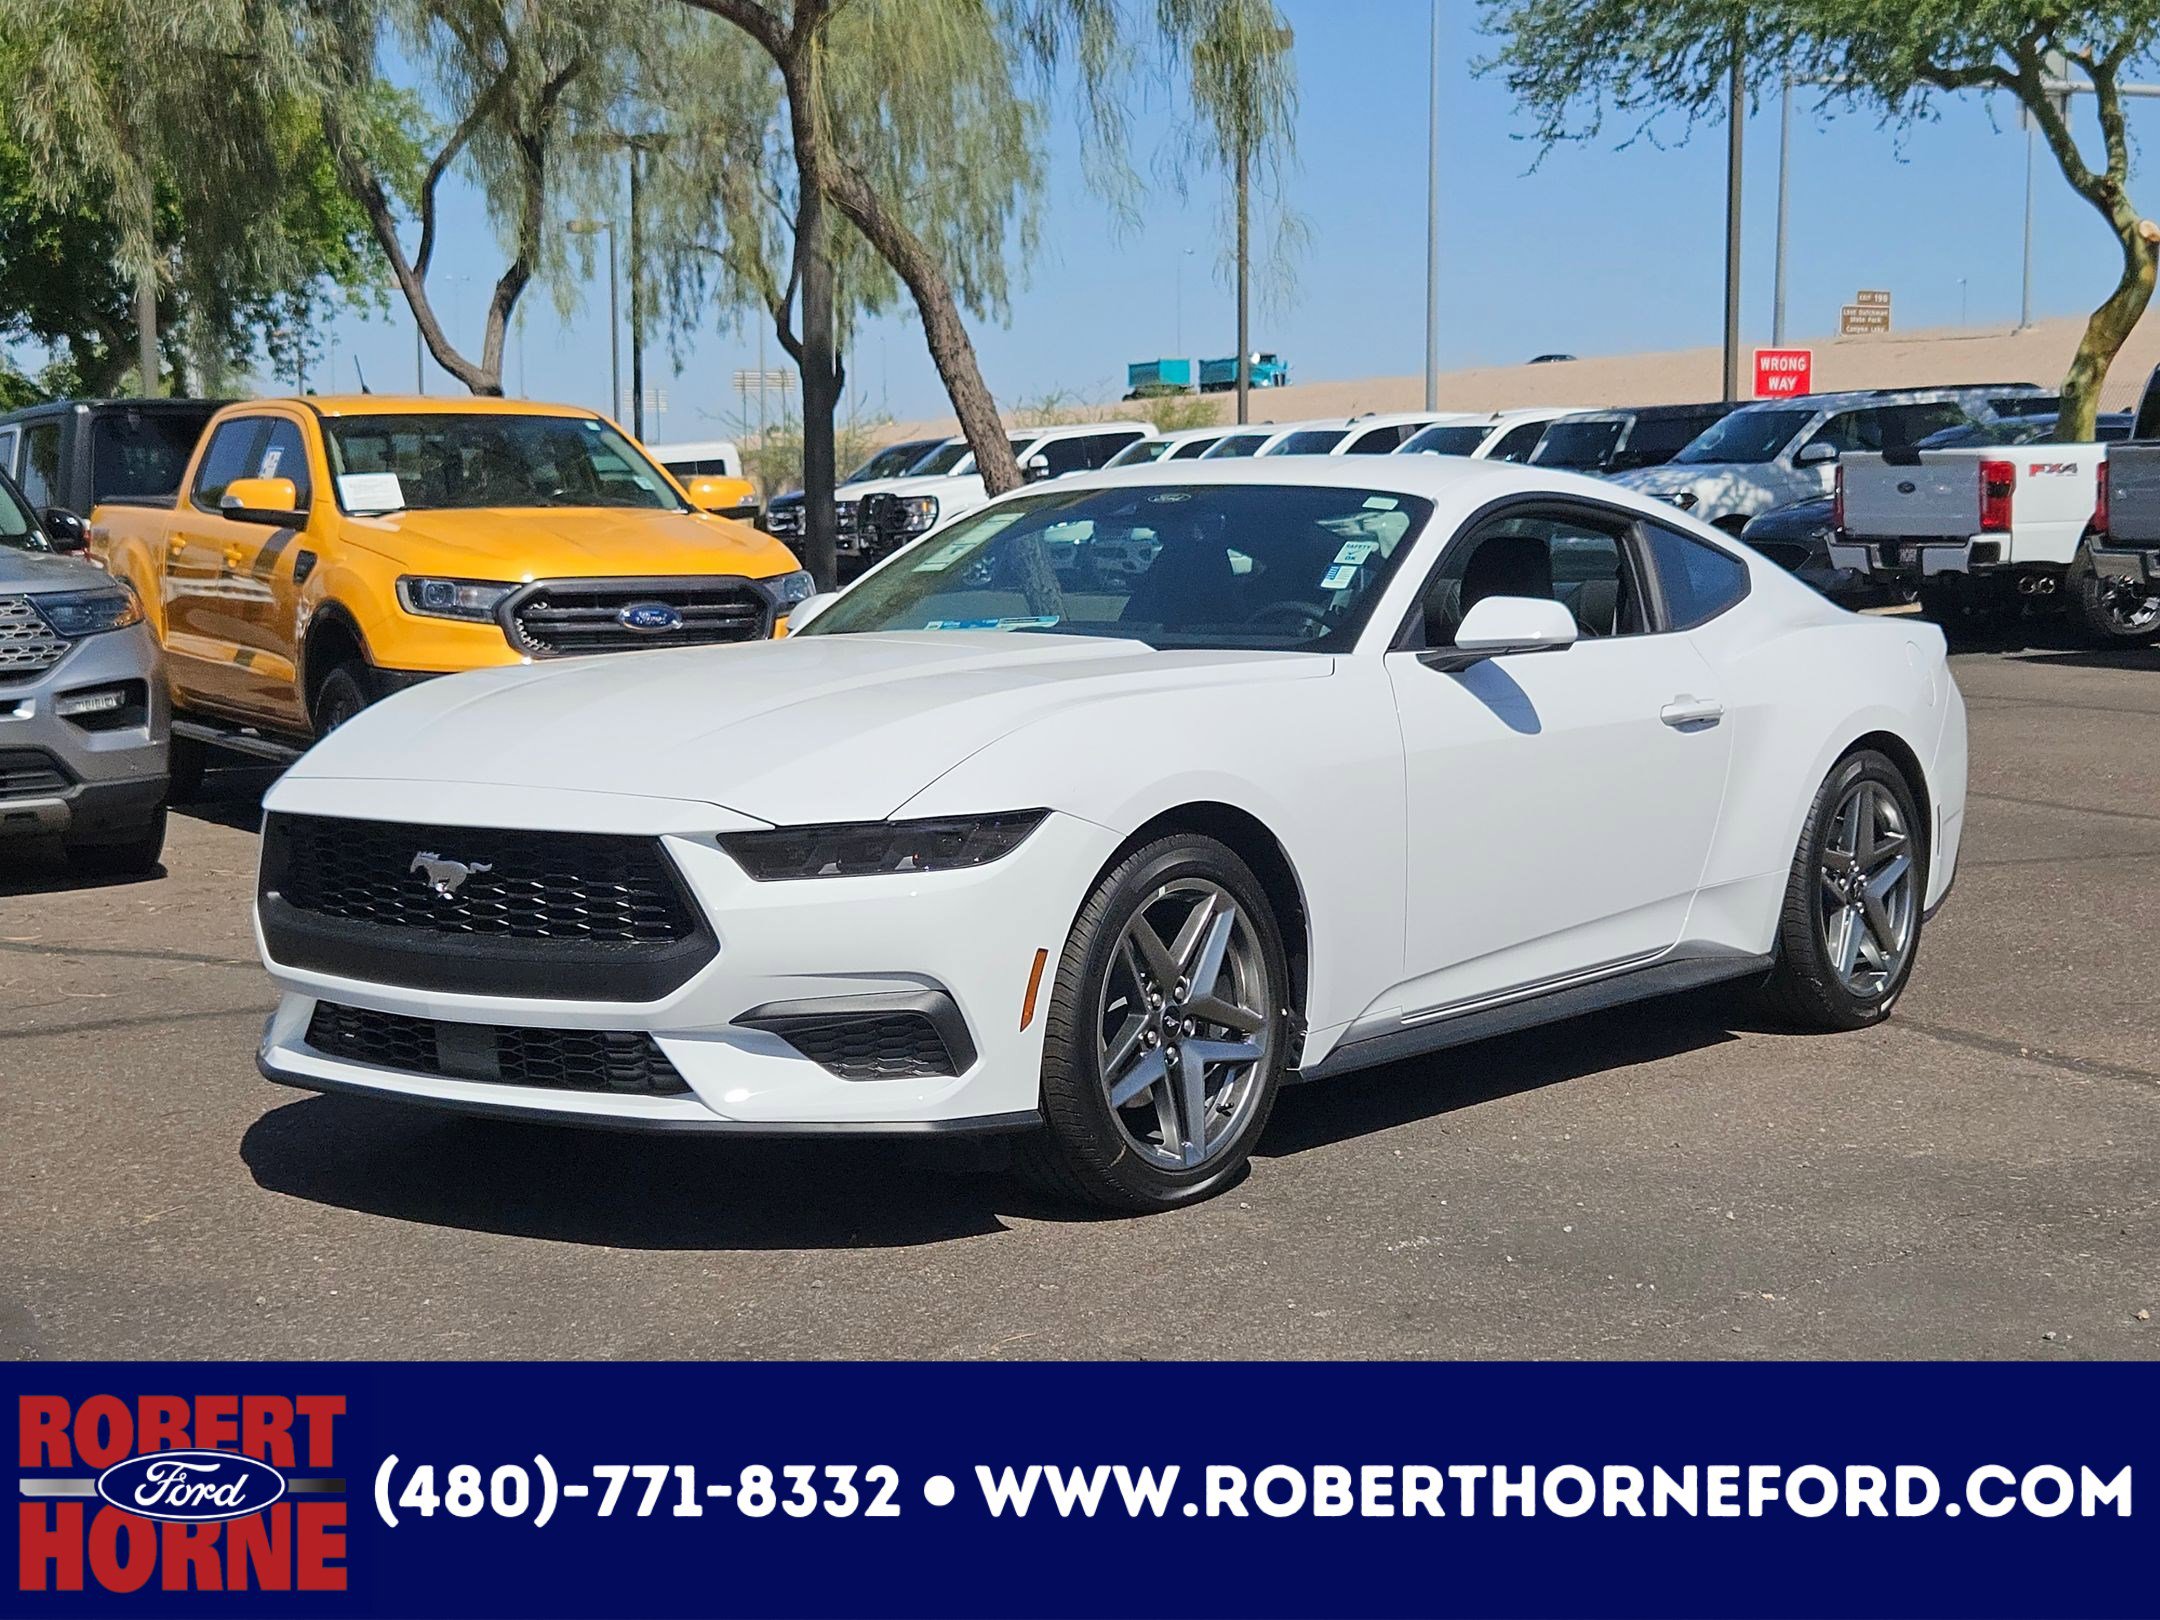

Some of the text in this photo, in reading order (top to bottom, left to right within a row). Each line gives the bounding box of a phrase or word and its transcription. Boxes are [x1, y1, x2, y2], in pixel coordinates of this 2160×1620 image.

[1760, 356, 1807, 372] WRONG
[1768, 375, 1797, 391] WAY
[635, 609, 668, 625] Ford
